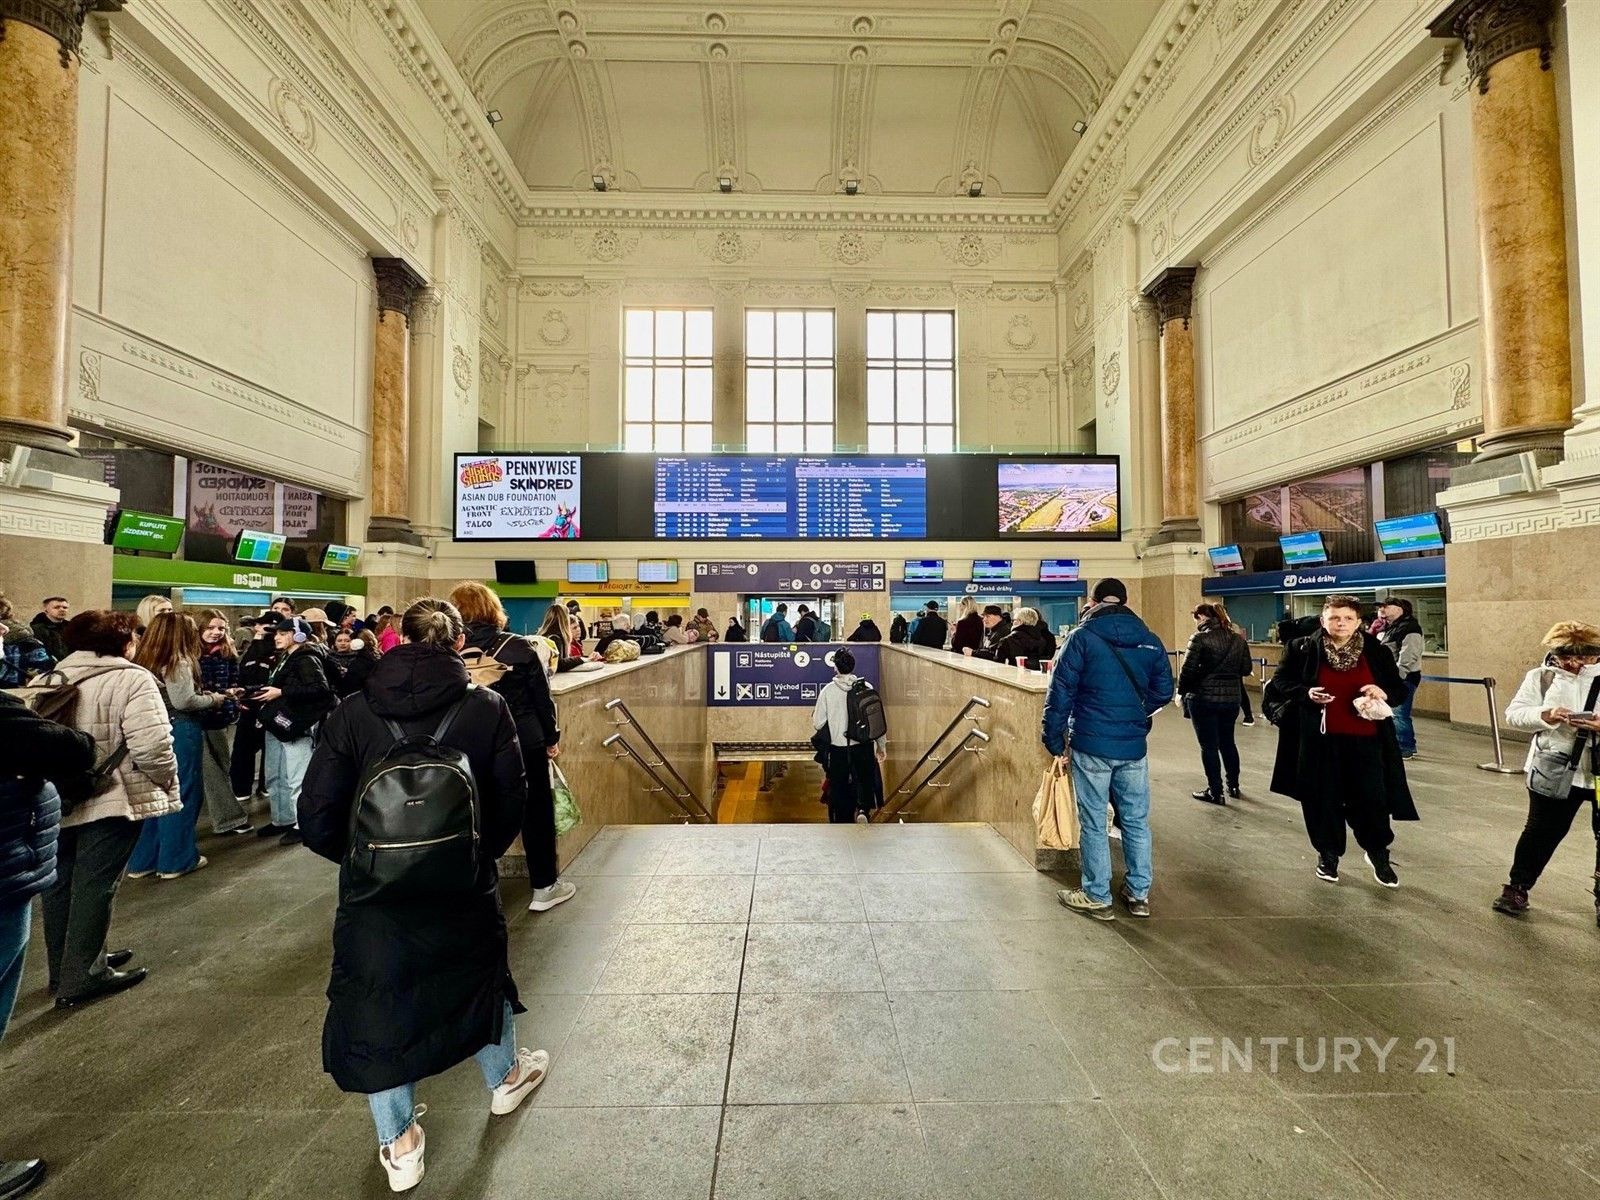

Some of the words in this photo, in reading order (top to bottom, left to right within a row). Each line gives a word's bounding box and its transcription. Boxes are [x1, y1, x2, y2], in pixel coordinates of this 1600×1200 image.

[506, 460, 577, 475] PENNYWISE
[510, 477, 573, 492] SKINDRED
[461, 493, 486, 501] ASIAN
[487, 493, 505, 502] DUB
[506, 493, 557, 502] FOUNDATION
[465, 520, 493, 528] TALCO
[233, 573, 248, 586] IDS
[262, 576, 278, 588] JMK
[1298, 576, 1316, 584] České
[1317, 575, 1337, 584] dráhy
